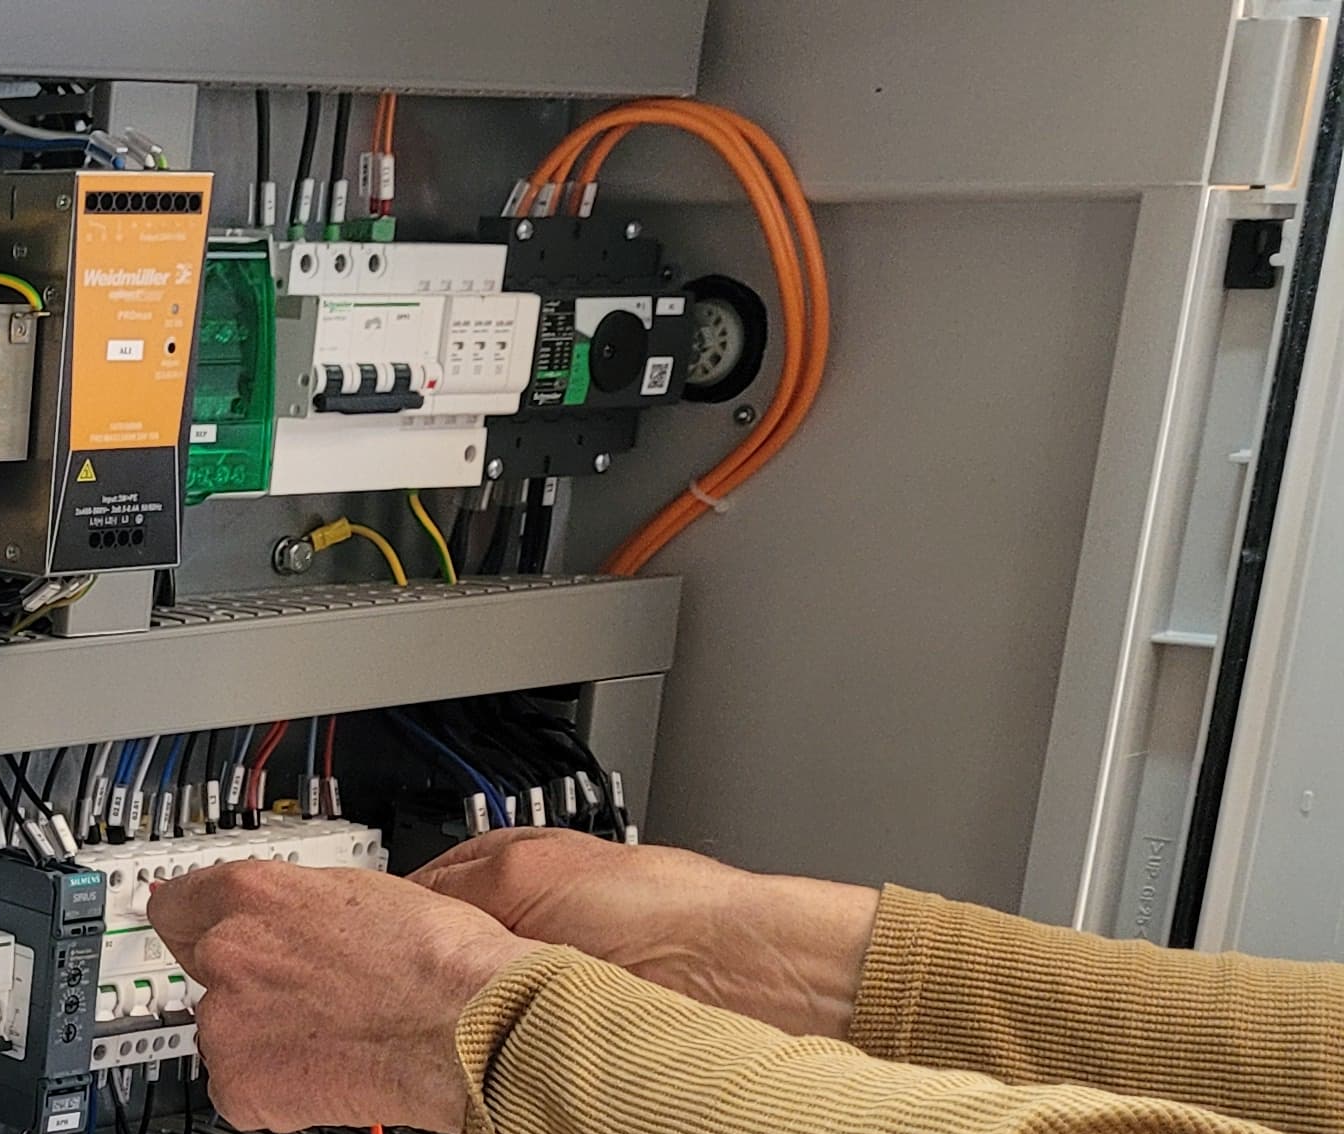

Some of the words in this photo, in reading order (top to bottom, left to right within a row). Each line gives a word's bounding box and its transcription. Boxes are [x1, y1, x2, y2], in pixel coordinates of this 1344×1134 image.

[84, 268, 172, 287] Weidmüller
[70, 876, 101, 887] SIEMENS
[72, 892, 97, 903] SIRIUS
